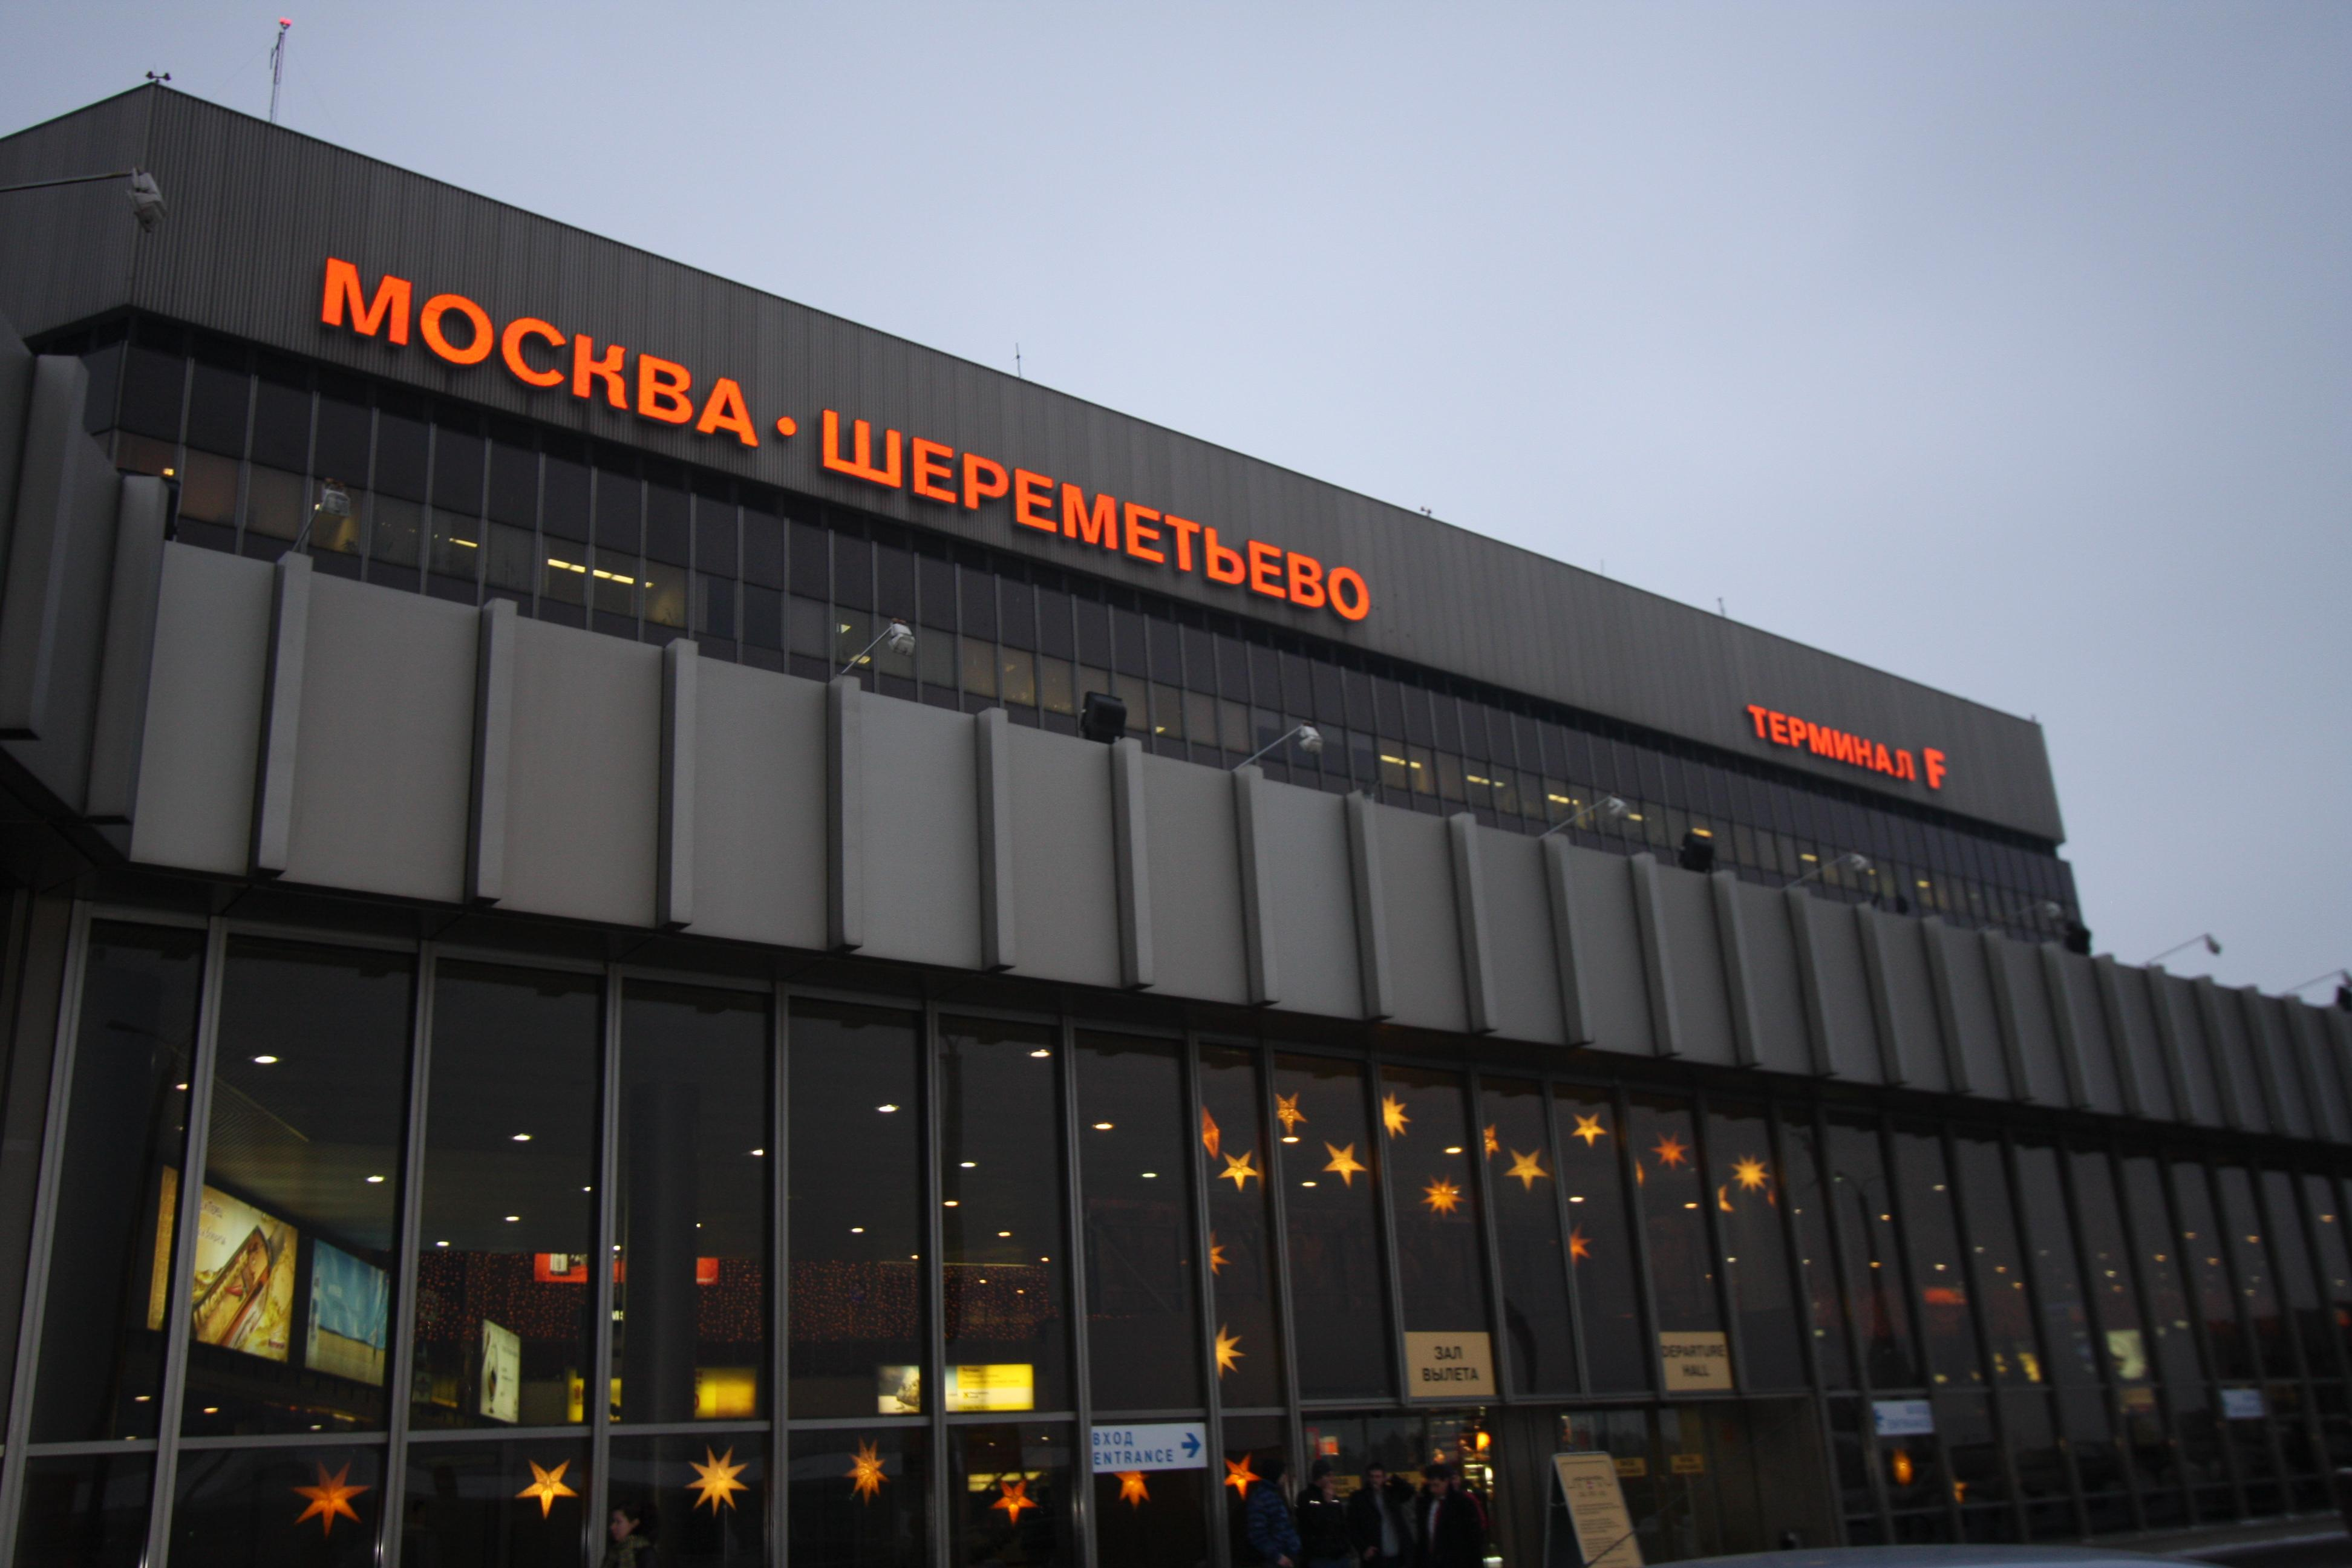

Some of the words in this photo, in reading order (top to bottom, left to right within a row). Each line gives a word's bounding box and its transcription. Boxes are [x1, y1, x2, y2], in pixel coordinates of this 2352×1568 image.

[321, 256, 759, 448] МОСКВА
[822, 408, 1371, 622] ШЕРЕМЕТЬЕВО
[1746, 704, 1916, 782] ТЕРМИНАЛ
[1922, 746, 1947, 789] F
[1434, 1345, 1463, 1360] ЗАЛ
[1662, 1344, 1725, 1357] DEPARTURE
[1422, 1367, 1480, 1382] ВЫЛЕТА
[1093, 1431, 1134, 1446] ВХОД
[1093, 1449, 1174, 1465] ENTRANCE
